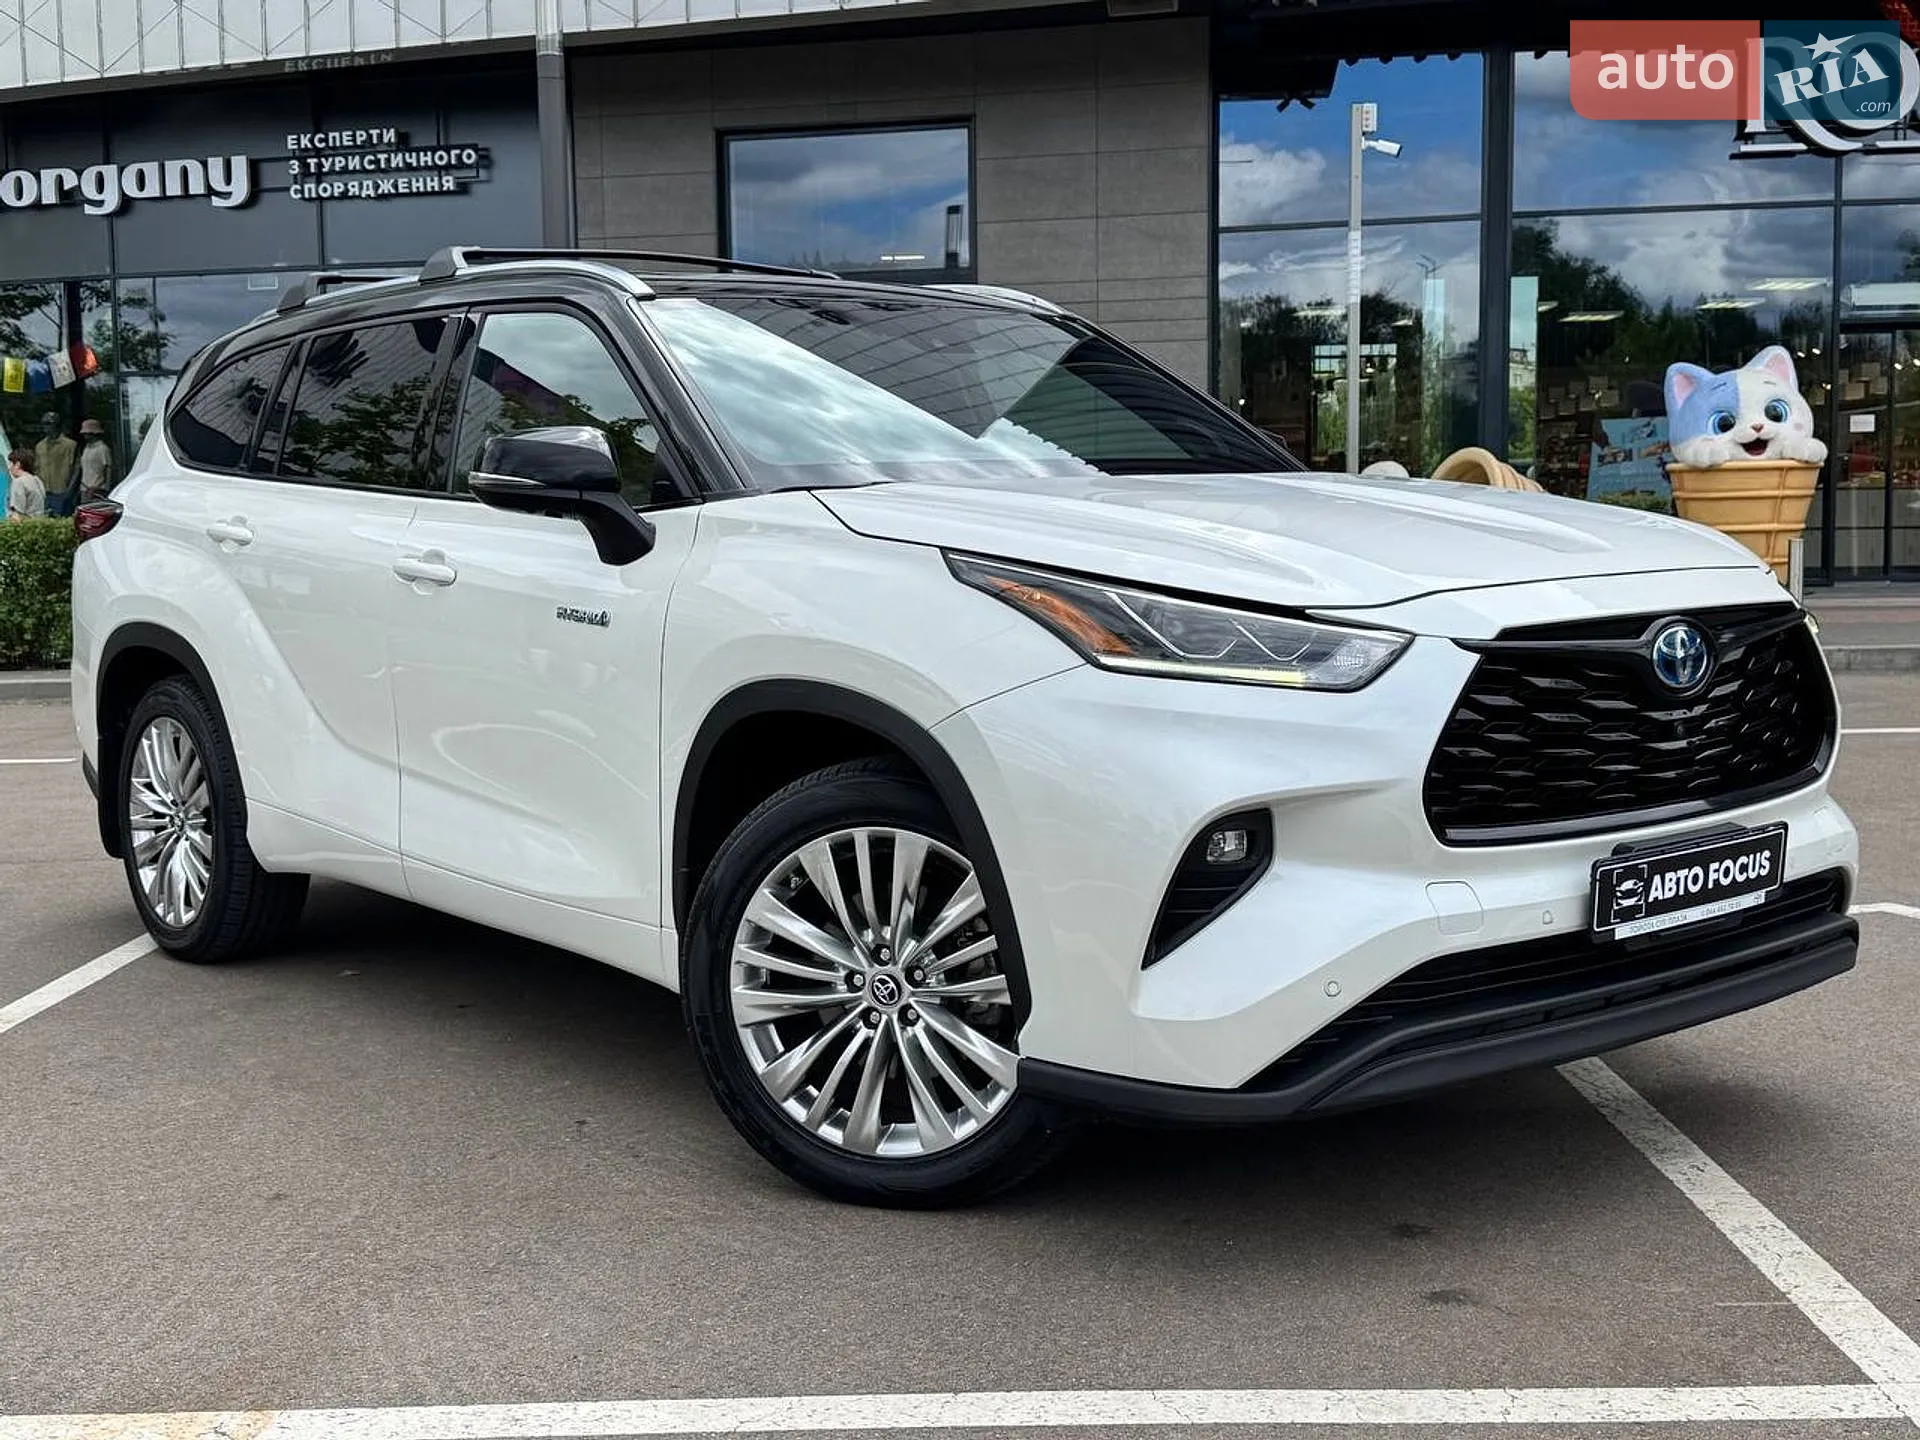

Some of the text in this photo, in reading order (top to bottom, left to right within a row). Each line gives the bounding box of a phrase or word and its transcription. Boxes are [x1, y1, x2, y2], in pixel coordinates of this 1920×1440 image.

[287, 128, 396, 150] ЕКСПЕРТИ
[307, 149, 477, 174] ТУРИСТИЧНОГО
[0, 155, 250, 215] organy
[289, 176, 456, 200] СПОРЯДЖЕННЯ
[1708, 850, 1771, 888] FOCUS
